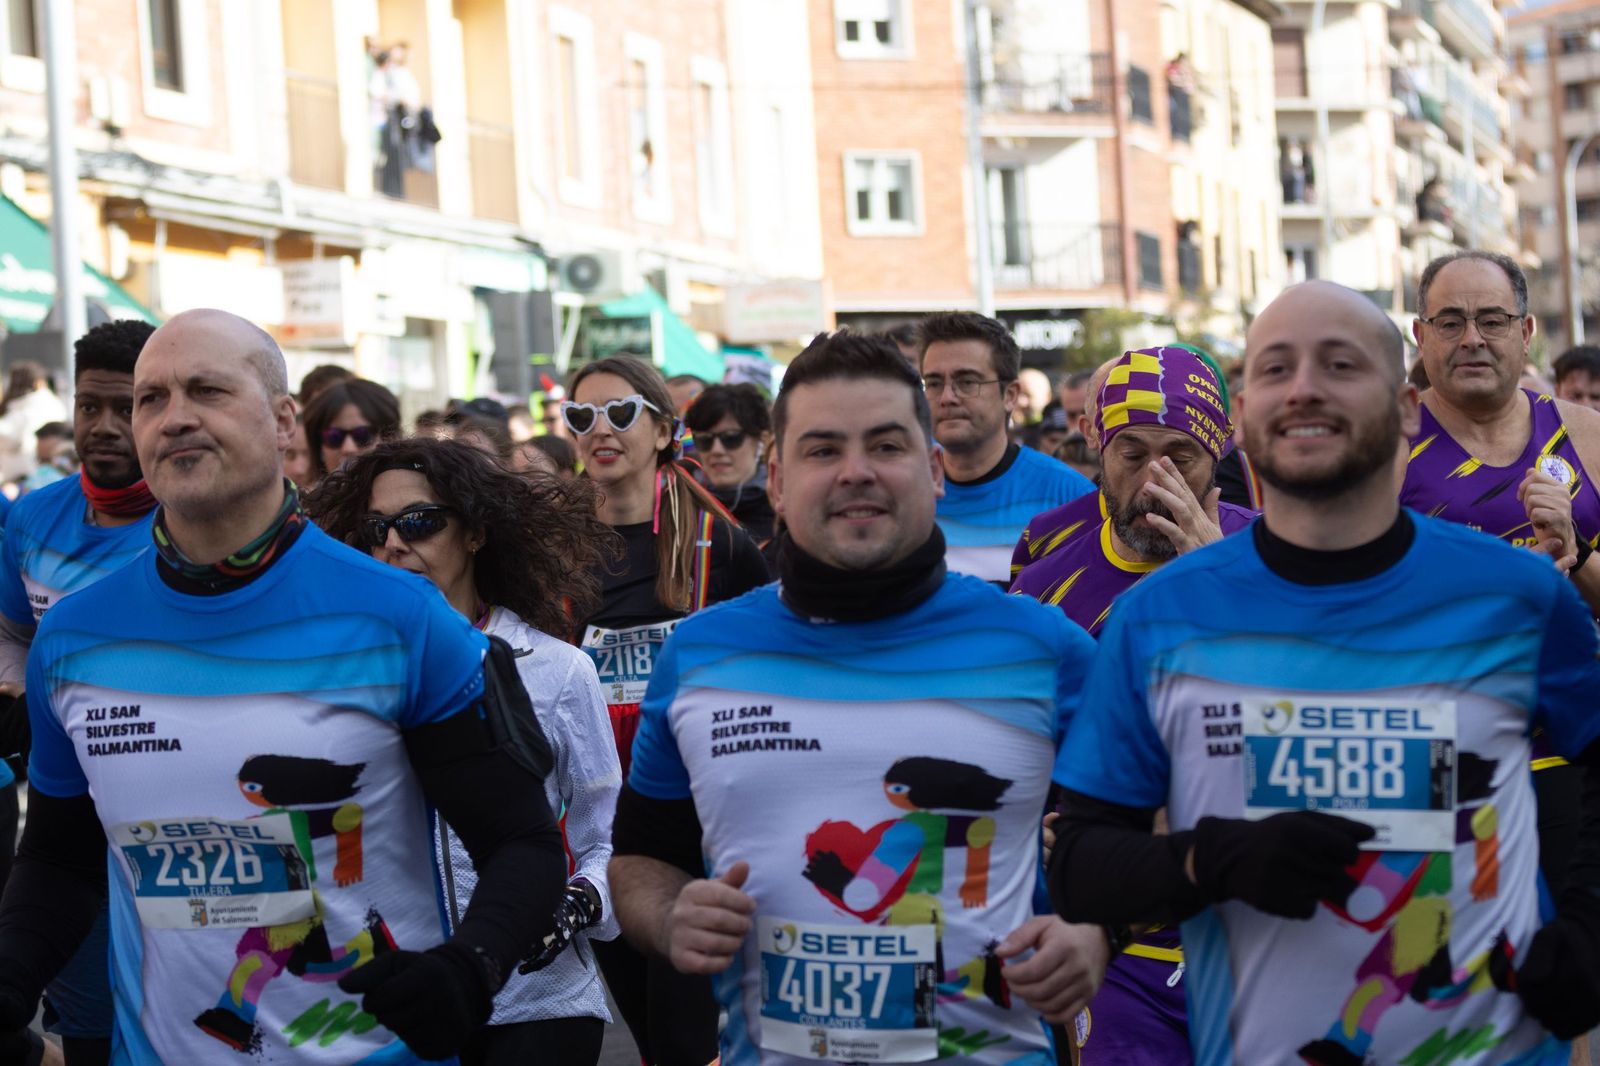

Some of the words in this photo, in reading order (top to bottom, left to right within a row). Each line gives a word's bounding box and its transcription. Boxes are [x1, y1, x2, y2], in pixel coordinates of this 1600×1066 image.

[1189, 420, 1210, 443] DEL
[35, 594, 49, 605] SAN
[596, 643, 652, 677] 2118
[613, 675, 639, 683] CELTA
[86, 708, 106, 722] XLI
[110, 705, 141, 719] SAN
[712, 709, 734, 723] XLI
[738, 705, 773, 719] SAN
[1299, 706, 1434, 732] SETEL
[86, 722, 156, 739] SILVESTRE
[711, 721, 791, 741] SILVESTRE
[87, 738, 182, 757] SALMANTINA
[711, 738, 822, 759] SALMANTINA
[1267, 737, 1405, 799] 4588
[1332, 797, 1369, 809] POLO
[160, 821, 275, 841] SETEL
[146, 840, 264, 887] 2326
[211, 916, 220, 924] de
[221, 915, 258, 924] Salamanca
[801, 931, 918, 957] SETEL
[777, 959, 892, 1020] 4037
